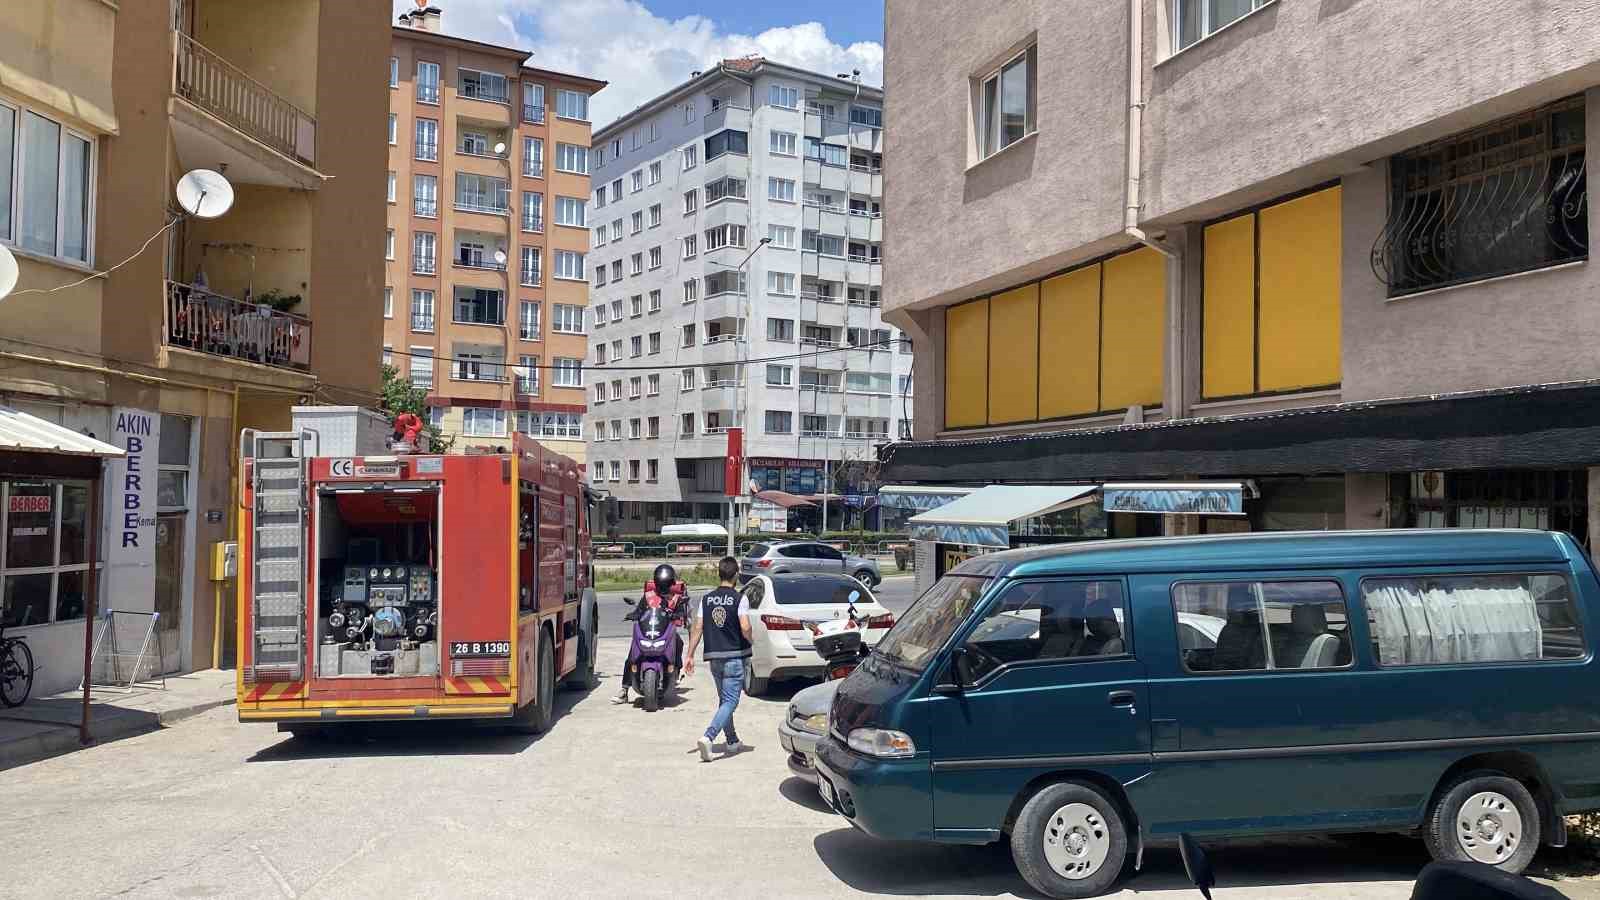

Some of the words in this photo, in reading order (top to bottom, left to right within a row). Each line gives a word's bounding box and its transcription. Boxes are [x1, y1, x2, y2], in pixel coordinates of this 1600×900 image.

[116, 412, 151, 437] AKIN
[333, 460, 352, 475] CE
[122, 437, 143, 548] BERBER
[11, 496, 49, 511] BERBER
[455, 643, 468, 654] 26
[472, 643, 481, 653] B
[485, 642, 509, 653] 1390
